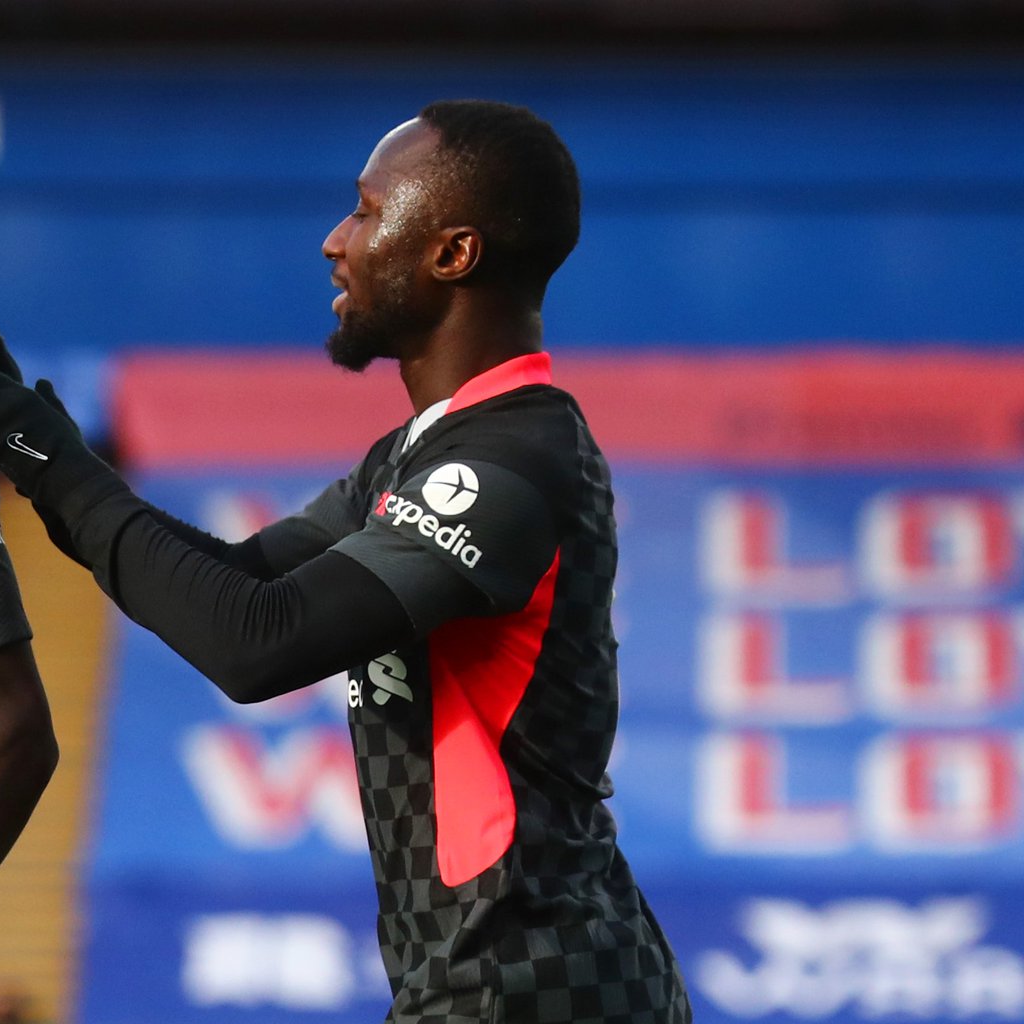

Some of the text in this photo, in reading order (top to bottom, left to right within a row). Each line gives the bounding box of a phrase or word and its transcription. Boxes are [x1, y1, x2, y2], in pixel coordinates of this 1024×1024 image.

[696, 490, 1024, 602] LO
[694, 608, 1024, 724] LO
[692, 730, 1024, 852] LO
